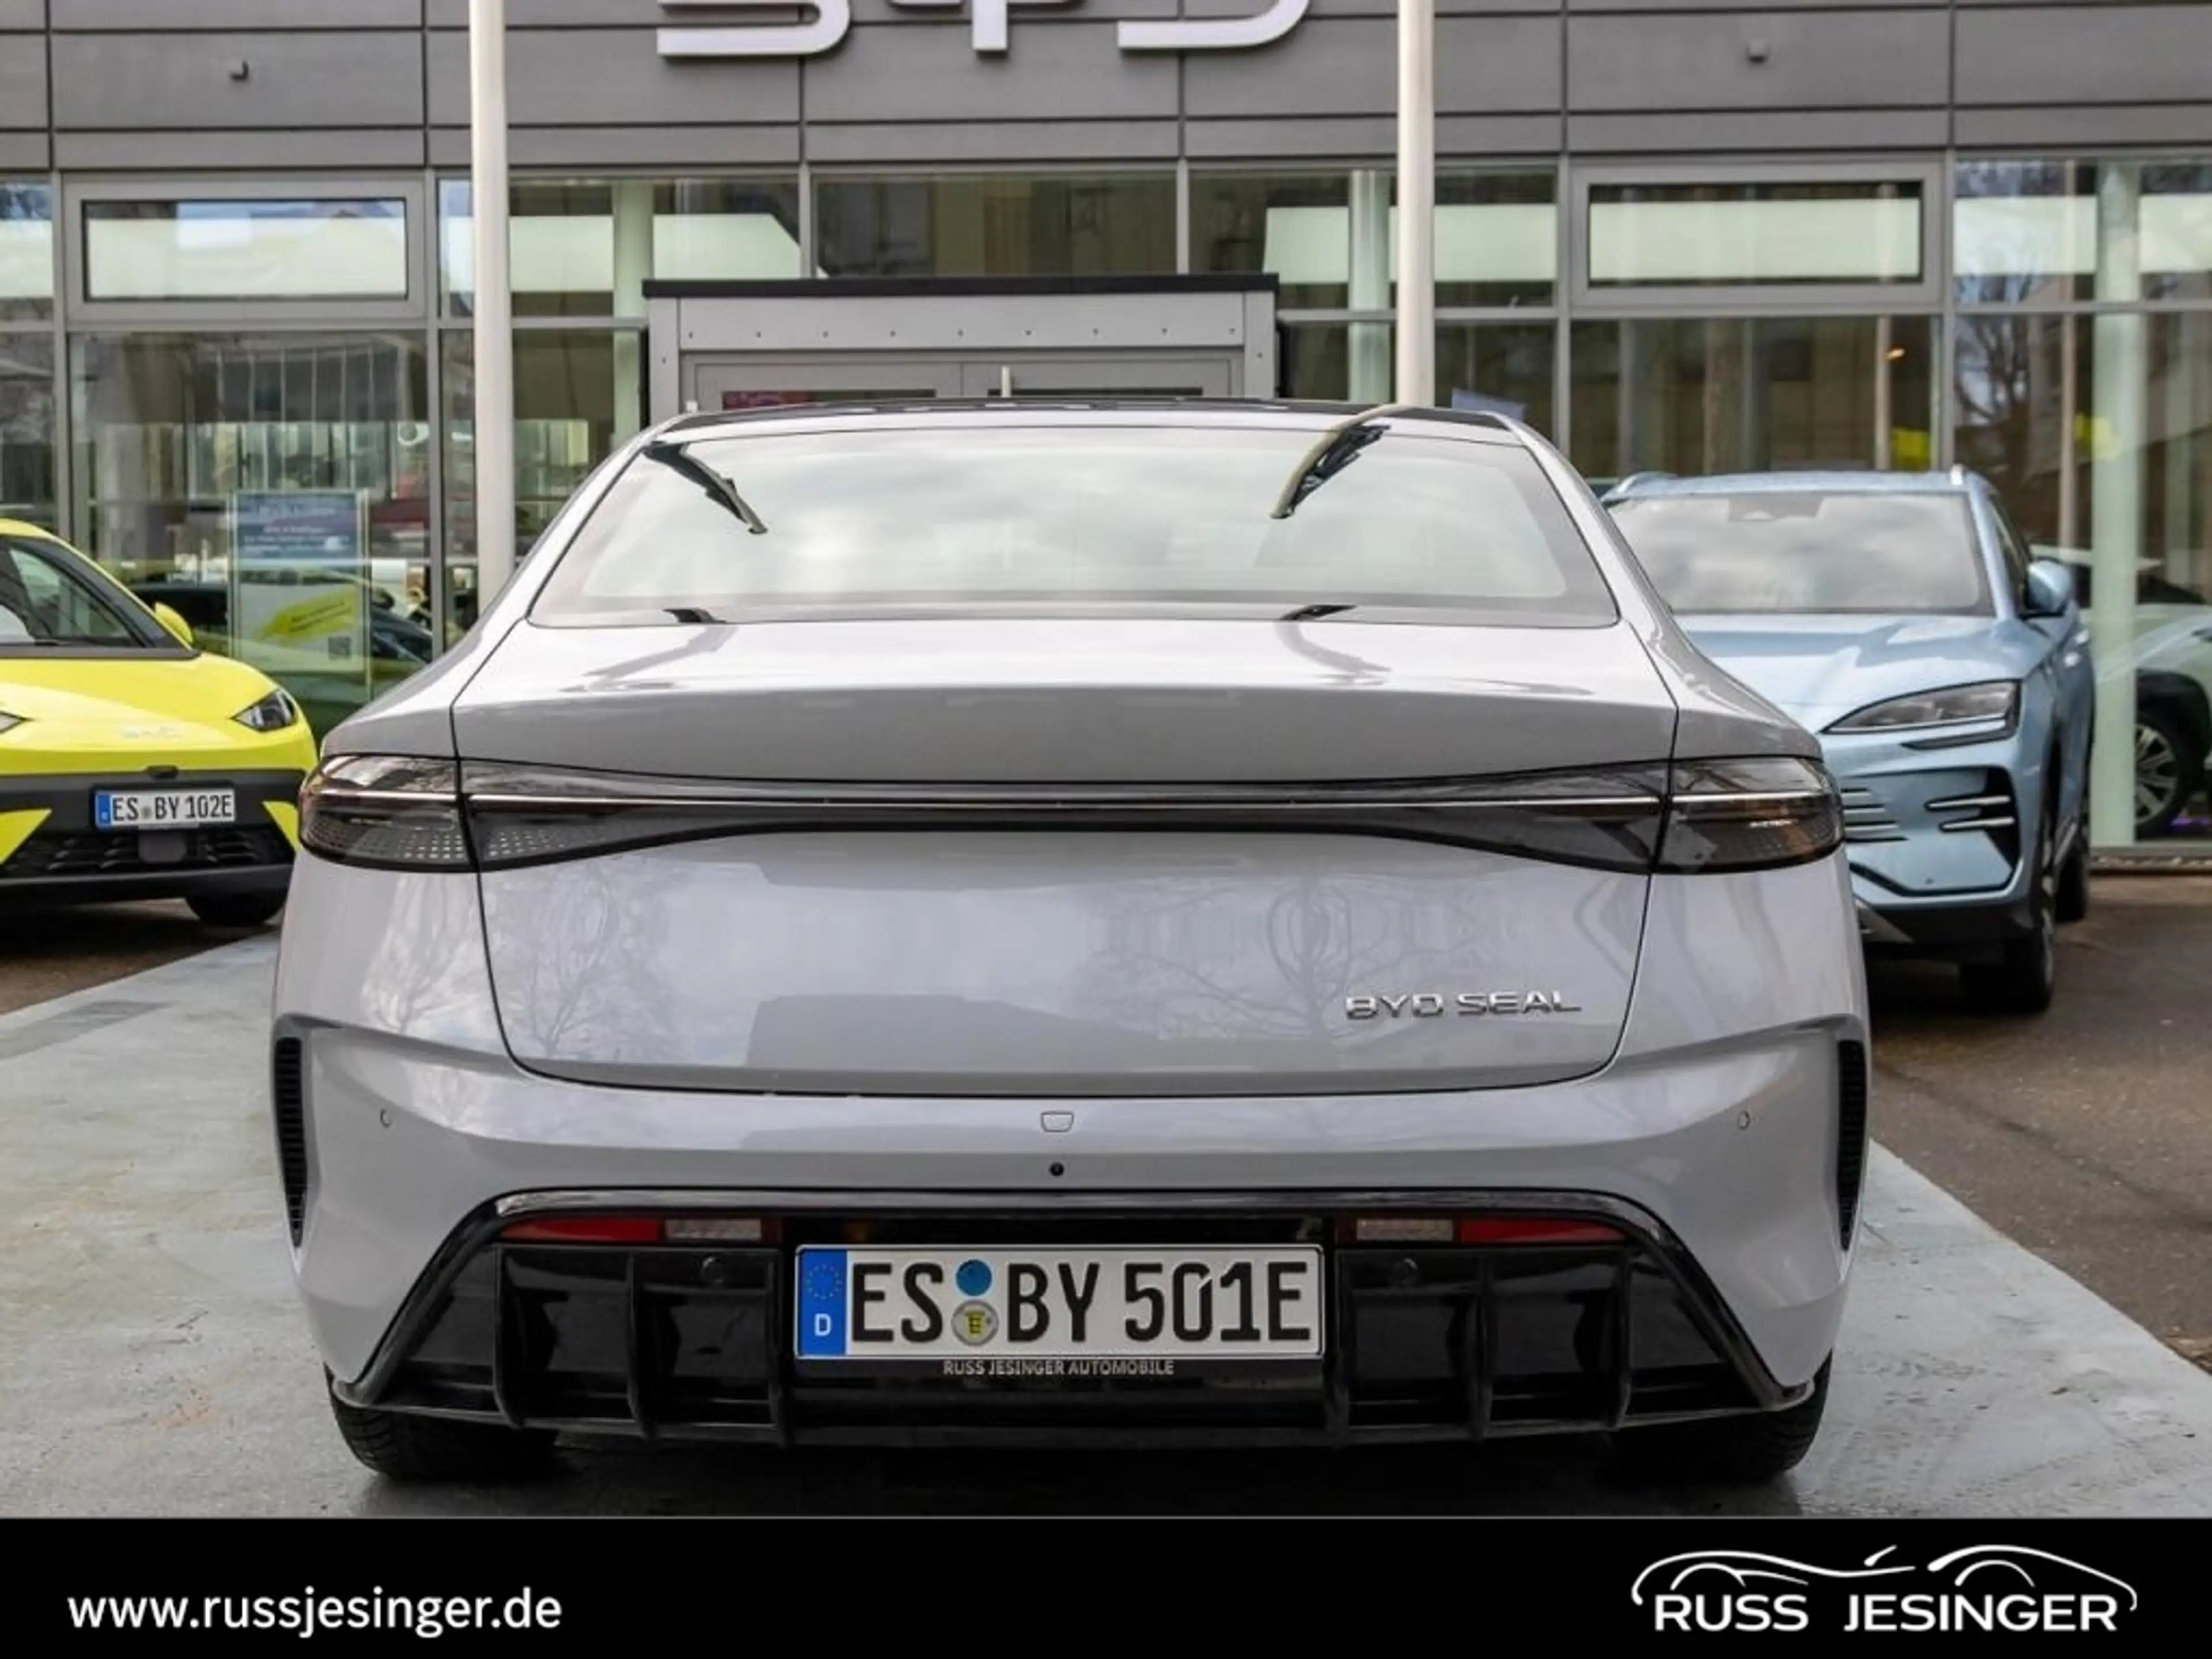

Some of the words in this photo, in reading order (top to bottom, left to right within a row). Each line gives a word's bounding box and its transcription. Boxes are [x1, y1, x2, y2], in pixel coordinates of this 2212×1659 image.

[112, 797, 139, 821] ES
[155, 796, 180, 819] BY
[185, 795, 232, 819] 102E
[1346, 993, 1444, 1020] BYD
[1456, 990, 1582, 1016] SEAL
[851, 1263, 944, 1343] ES
[1007, 1262, 1100, 1343] BY
[1124, 1262, 1311, 1343] 501E
[815, 1313, 831, 1336] D
[943, 1359, 986, 1376] RUSS
[988, 1359, 1065, 1376] JESINGER
[1067, 1359, 1175, 1376] AUTOMOBILE
